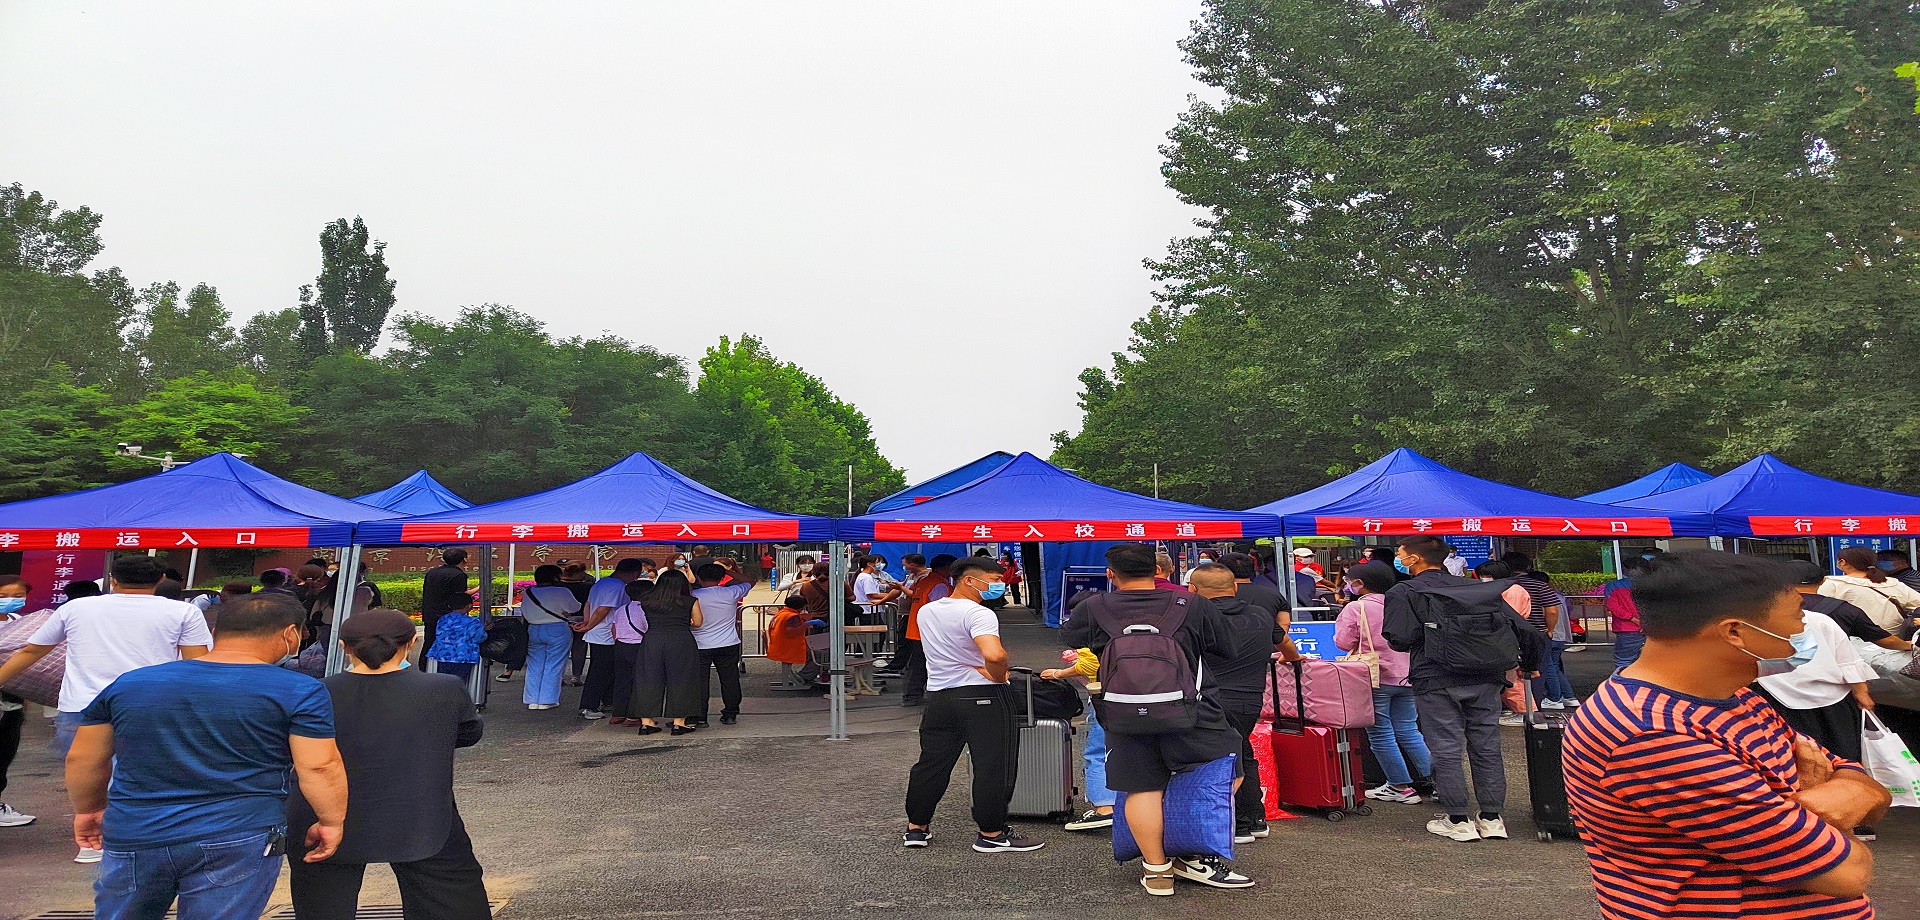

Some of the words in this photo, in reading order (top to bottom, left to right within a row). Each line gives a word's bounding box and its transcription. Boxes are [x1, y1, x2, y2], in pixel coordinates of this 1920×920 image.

[455, 523, 750, 539] 行李搬运入口
[921, 523, 1197, 539] 学生入校通道
[1362, 518, 1628, 533] 行李搬运入口
[1793, 518, 1908, 532] 行李搬
[0, 531, 256, 548] 李搬运入口
[51, 553, 76, 604] 行李通道
